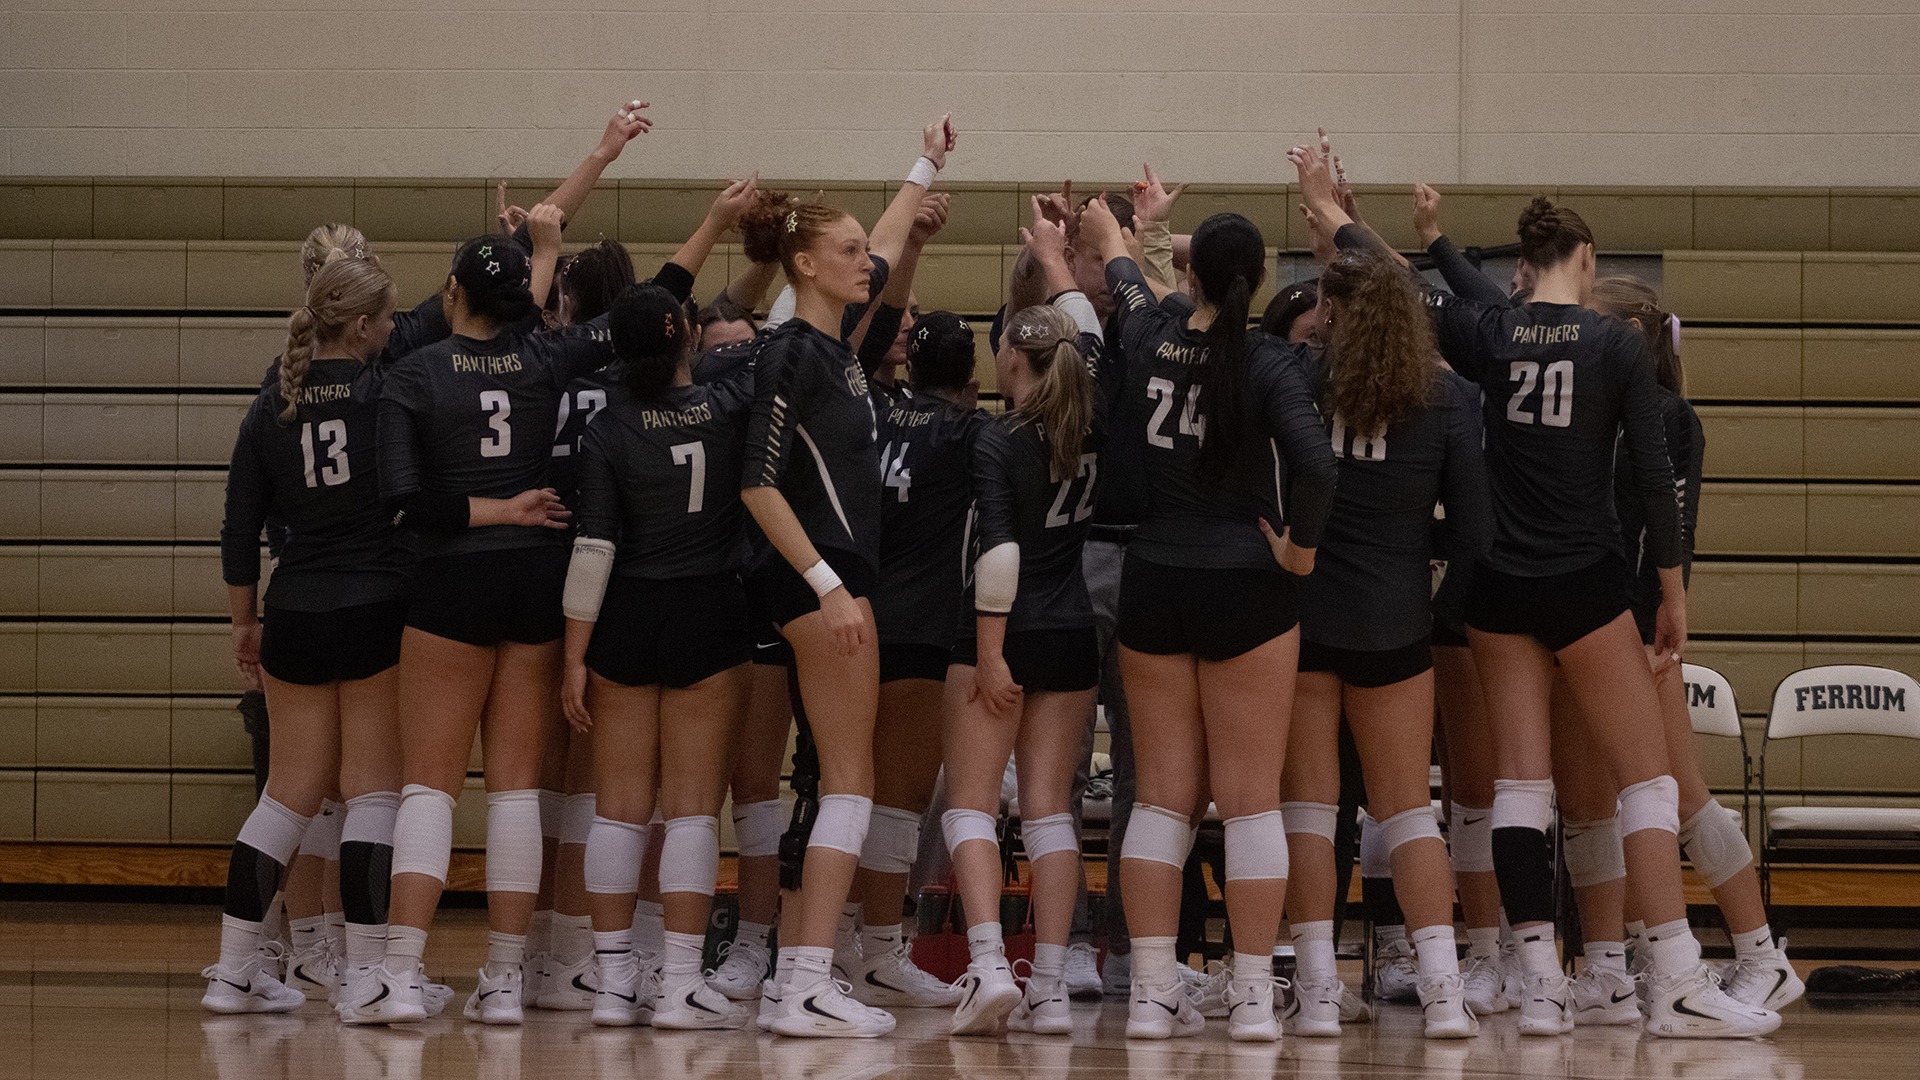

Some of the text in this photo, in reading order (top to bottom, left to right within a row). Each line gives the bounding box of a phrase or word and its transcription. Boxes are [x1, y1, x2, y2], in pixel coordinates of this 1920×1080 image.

[452, 353, 522, 375] PANTHERS
[1512, 323, 1580, 345] PANTHERS
[296, 383, 351, 405] ANTHERS
[479, 389, 512, 458] 3
[641, 401, 712, 430] PANTHERS
[1146, 376, 1206, 450] 24
[1506, 360, 1575, 428] 20
[300, 418, 351, 488] 13
[1331, 411, 1388, 462] 18
[670, 440, 706, 513] 7
[879, 440, 912, 503] 14
[1044, 452, 1098, 528] 22
[1794, 684, 1905, 712] FERRUM
